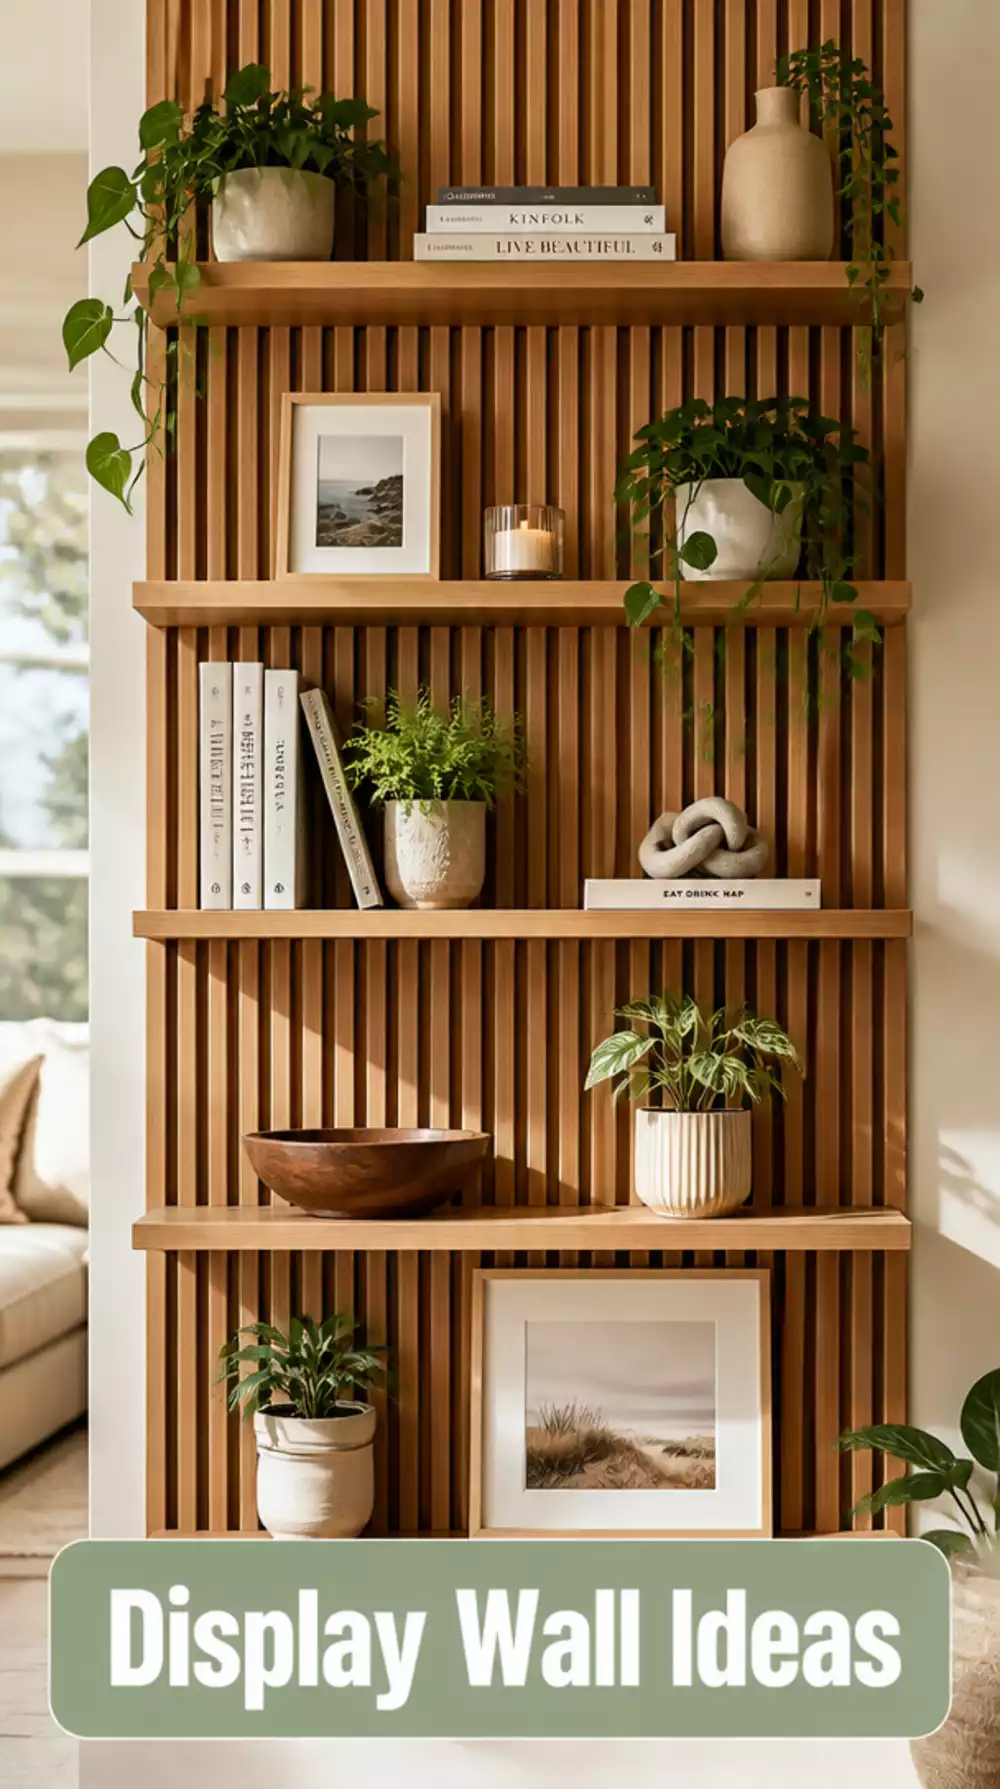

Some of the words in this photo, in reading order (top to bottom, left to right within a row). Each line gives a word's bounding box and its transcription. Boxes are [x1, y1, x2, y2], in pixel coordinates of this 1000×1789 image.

[509, 213, 584, 225] KINFOLK
[496, 240, 536, 254] LIVE
[540, 240, 636, 254] BEAUTIFUL
[663, 890, 683, 898] EAT
